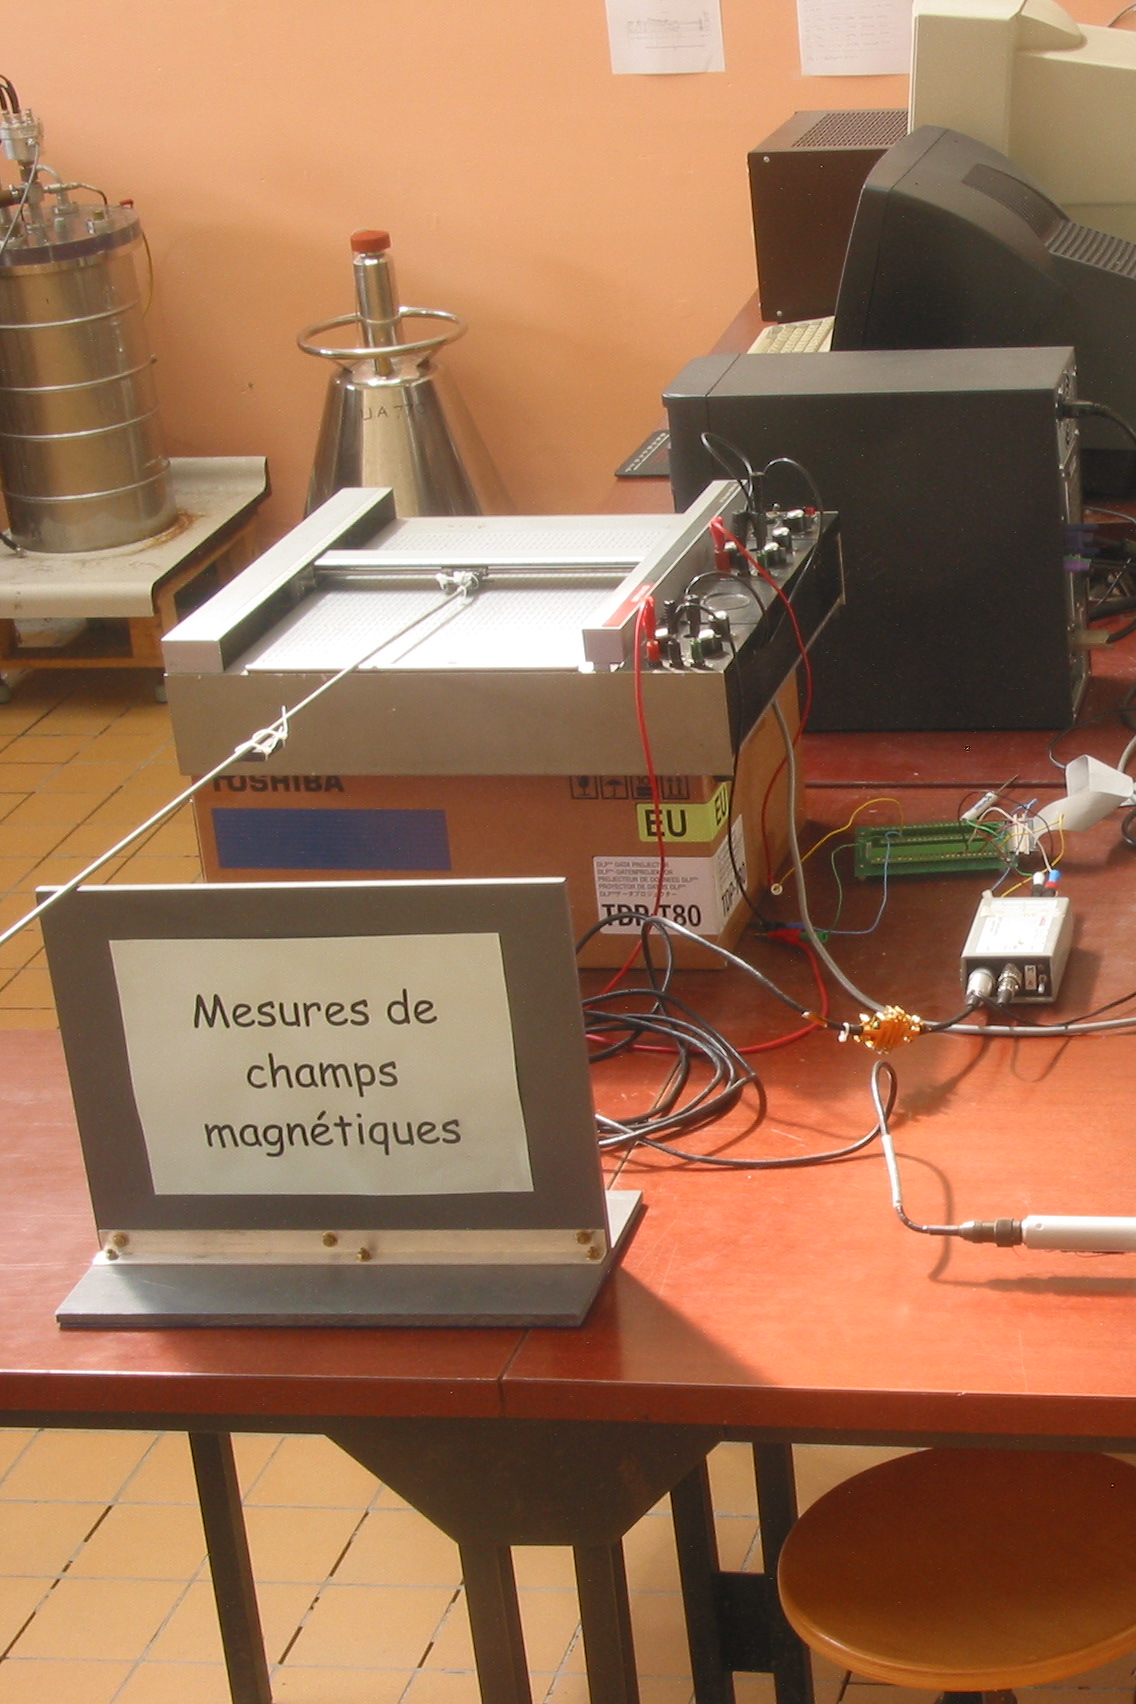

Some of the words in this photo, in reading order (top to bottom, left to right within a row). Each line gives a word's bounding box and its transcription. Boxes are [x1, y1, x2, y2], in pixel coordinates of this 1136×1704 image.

[213, 775, 345, 792] TOSHIBA
[645, 809, 687, 837] EU
[714, 786, 728, 826] EU
[601, 904, 701, 926] TDPT80
[193, 993, 371, 1028] Mesures
[386, 988, 438, 1025] de
[246, 1052, 398, 1098] champs
[204, 1110, 462, 1158] magnétiques
